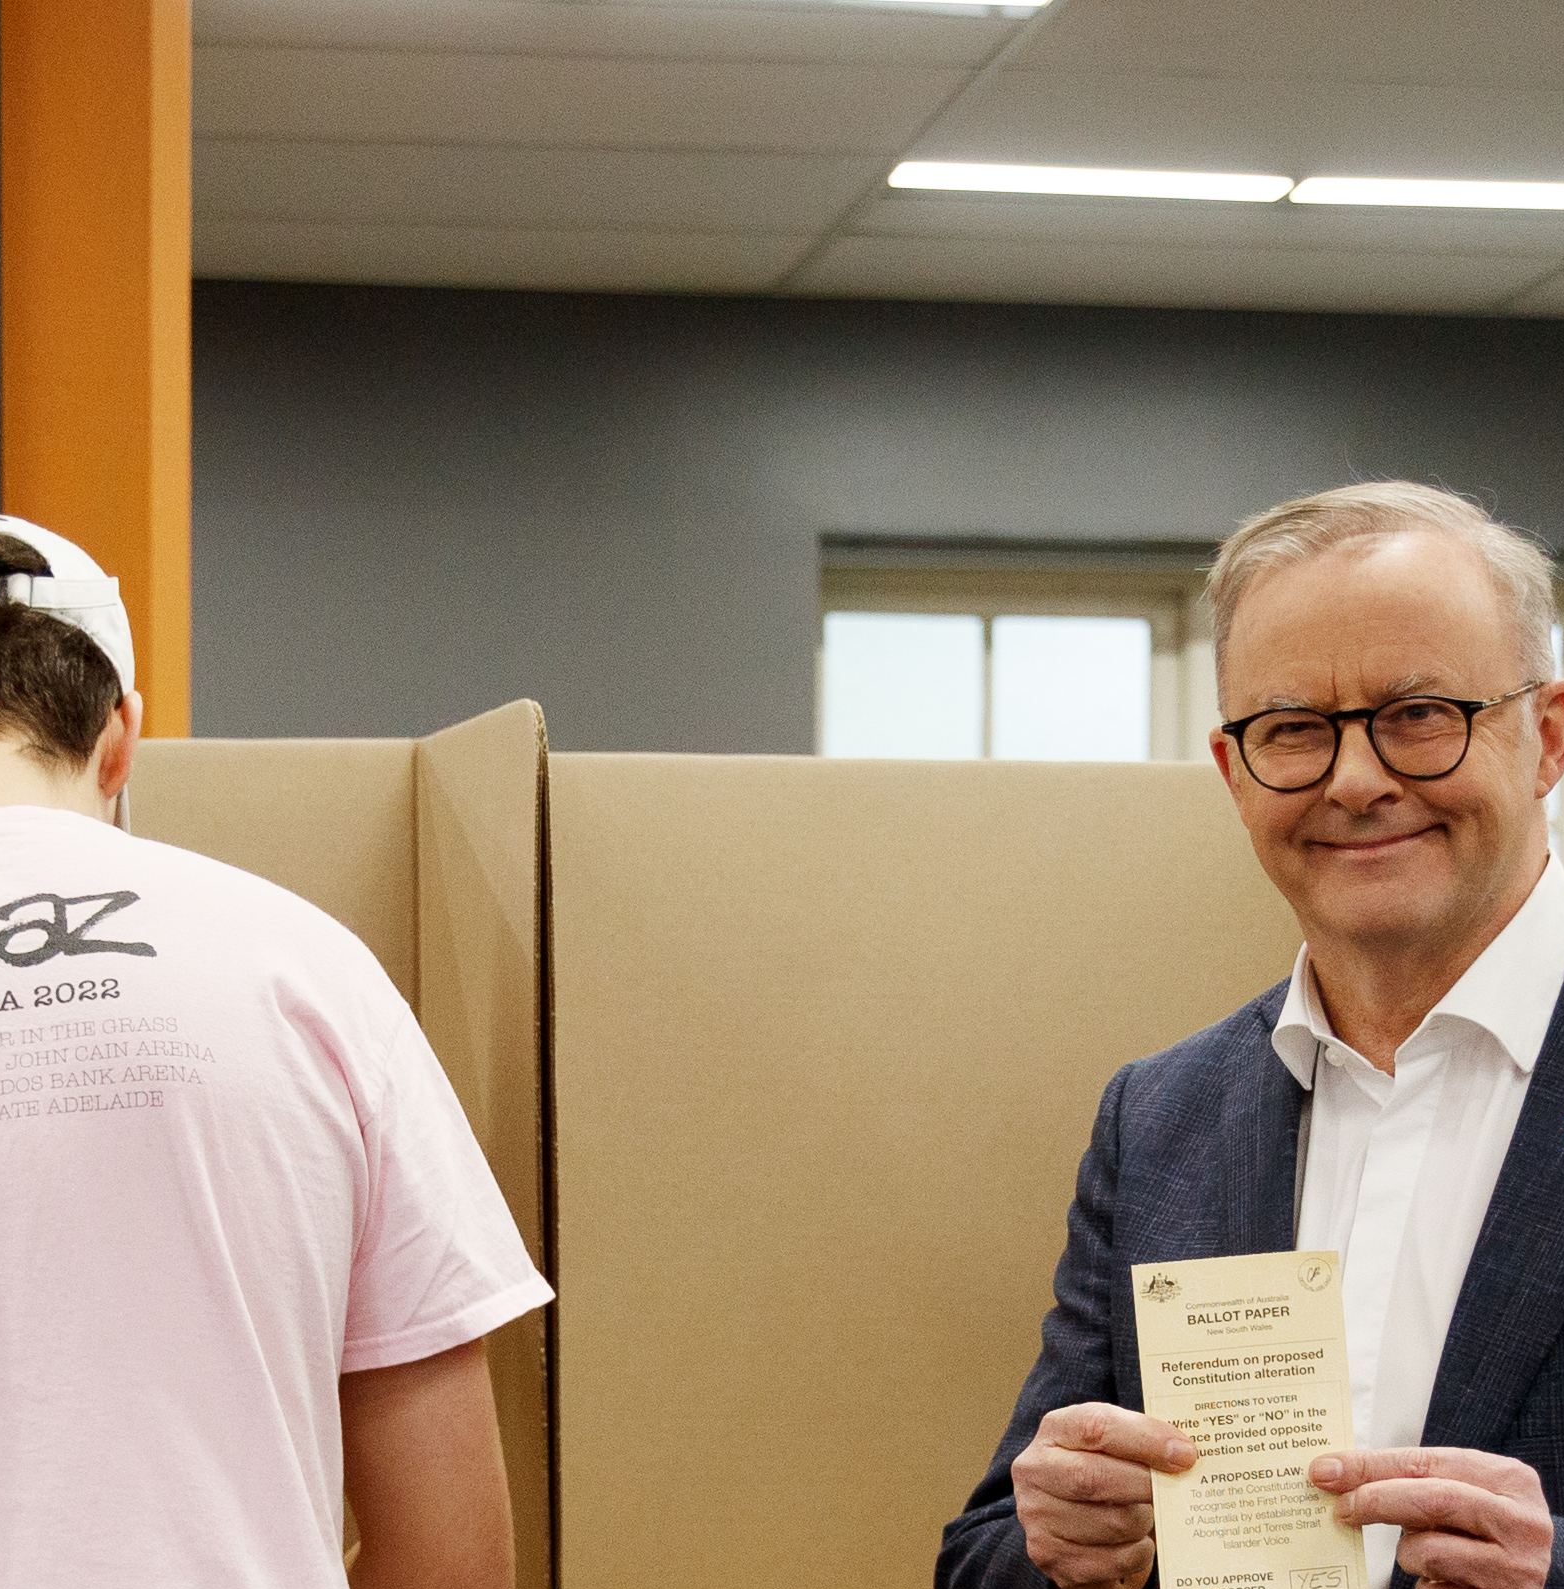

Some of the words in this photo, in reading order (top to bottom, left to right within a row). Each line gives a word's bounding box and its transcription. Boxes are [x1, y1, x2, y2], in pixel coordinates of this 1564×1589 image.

[33, 977, 121, 1007] 2022
[21, 1027, 45, 1046] IN
[49, 1020, 97, 1039] THE
[102, 1016, 179, 1036] GRASS
[5, 1049, 69, 1071] JOHN
[74, 1041, 130, 1062] CAIN
[135, 1039, 217, 1064] ARENA
[49, 1068, 116, 1091] BANK
[121, 1063, 203, 1085] ARENA
[46, 1089, 165, 1116] ADELAIDE
[1185, 1299, 1245, 1311] Commonwealth
[1256, 1294, 1290, 1303] Australia
[1187, 1310, 1241, 1326] BALLOT
[1245, 1305, 1290, 1321] PAPER
[1206, 1328, 1224, 1336] New
[1225, 1326, 1248, 1334] South
[1250, 1323, 1273, 1332] Wales
[1161, 1357, 1239, 1373] Referendum
[1243, 1356, 1259, 1365] on
[1263, 1348, 1324, 1365] proposed
[1172, 1370, 1251, 1387] Constitution
[1254, 1365, 1315, 1380] alteration
[1195, 1400, 1250, 1411] DIRECTIONS
[1253, 1397, 1265, 1405] TO
[1267, 1394, 1298, 1404] VOTER
[1168, 1416, 1200, 1429] Write
[1243, 1414, 1256, 1423] or
[1293, 1408, 1304, 1418] in
[1308, 1406, 1327, 1417] the
[1189, 1431, 1211, 1443] ace
[1214, 1425, 1267, 1443] provided
[1270, 1421, 1323, 1438] opposite
[1247, 1442, 1265, 1452] set
[1269, 1438, 1288, 1451] out
[1291, 1434, 1331, 1449] below.
[1200, 1476, 1208, 1484] A
[1211, 1469, 1274, 1484] PROPOSED
[1276, 1467, 1304, 1477] LAW:
[1191, 1489, 1202, 1498] To
[1204, 1488, 1225, 1498] alter
[1228, 1486, 1244, 1496] the
[1245, 1480, 1303, 1495] Constitution
[1189, 1501, 1237, 1513] recognise
[1239, 1498, 1255, 1507] the
[1257, 1497, 1278, 1506] First
[1280, 1492, 1320, 1504] Peoples
[1185, 1517, 1194, 1525] of
[1197, 1513, 1238, 1524] Australia
[1241, 1512, 1253, 1522] by
[1255, 1507, 1312, 1520] establishing
[1314, 1505, 1327, 1514] an
[1192, 1526, 1240, 1539] Aboriginal
[1242, 1524, 1262, 1534] and
[1264, 1521, 1293, 1532] Torres
[1295, 1518, 1321, 1530] Strait
[1223, 1539, 1261, 1549] Islander
[1263, 1536, 1293, 1546] Voice.
[1176, 1577, 1193, 1587] DO
[1195, 1575, 1219, 1586] YOU
[1222, 1571, 1274, 1584] APPROVE
